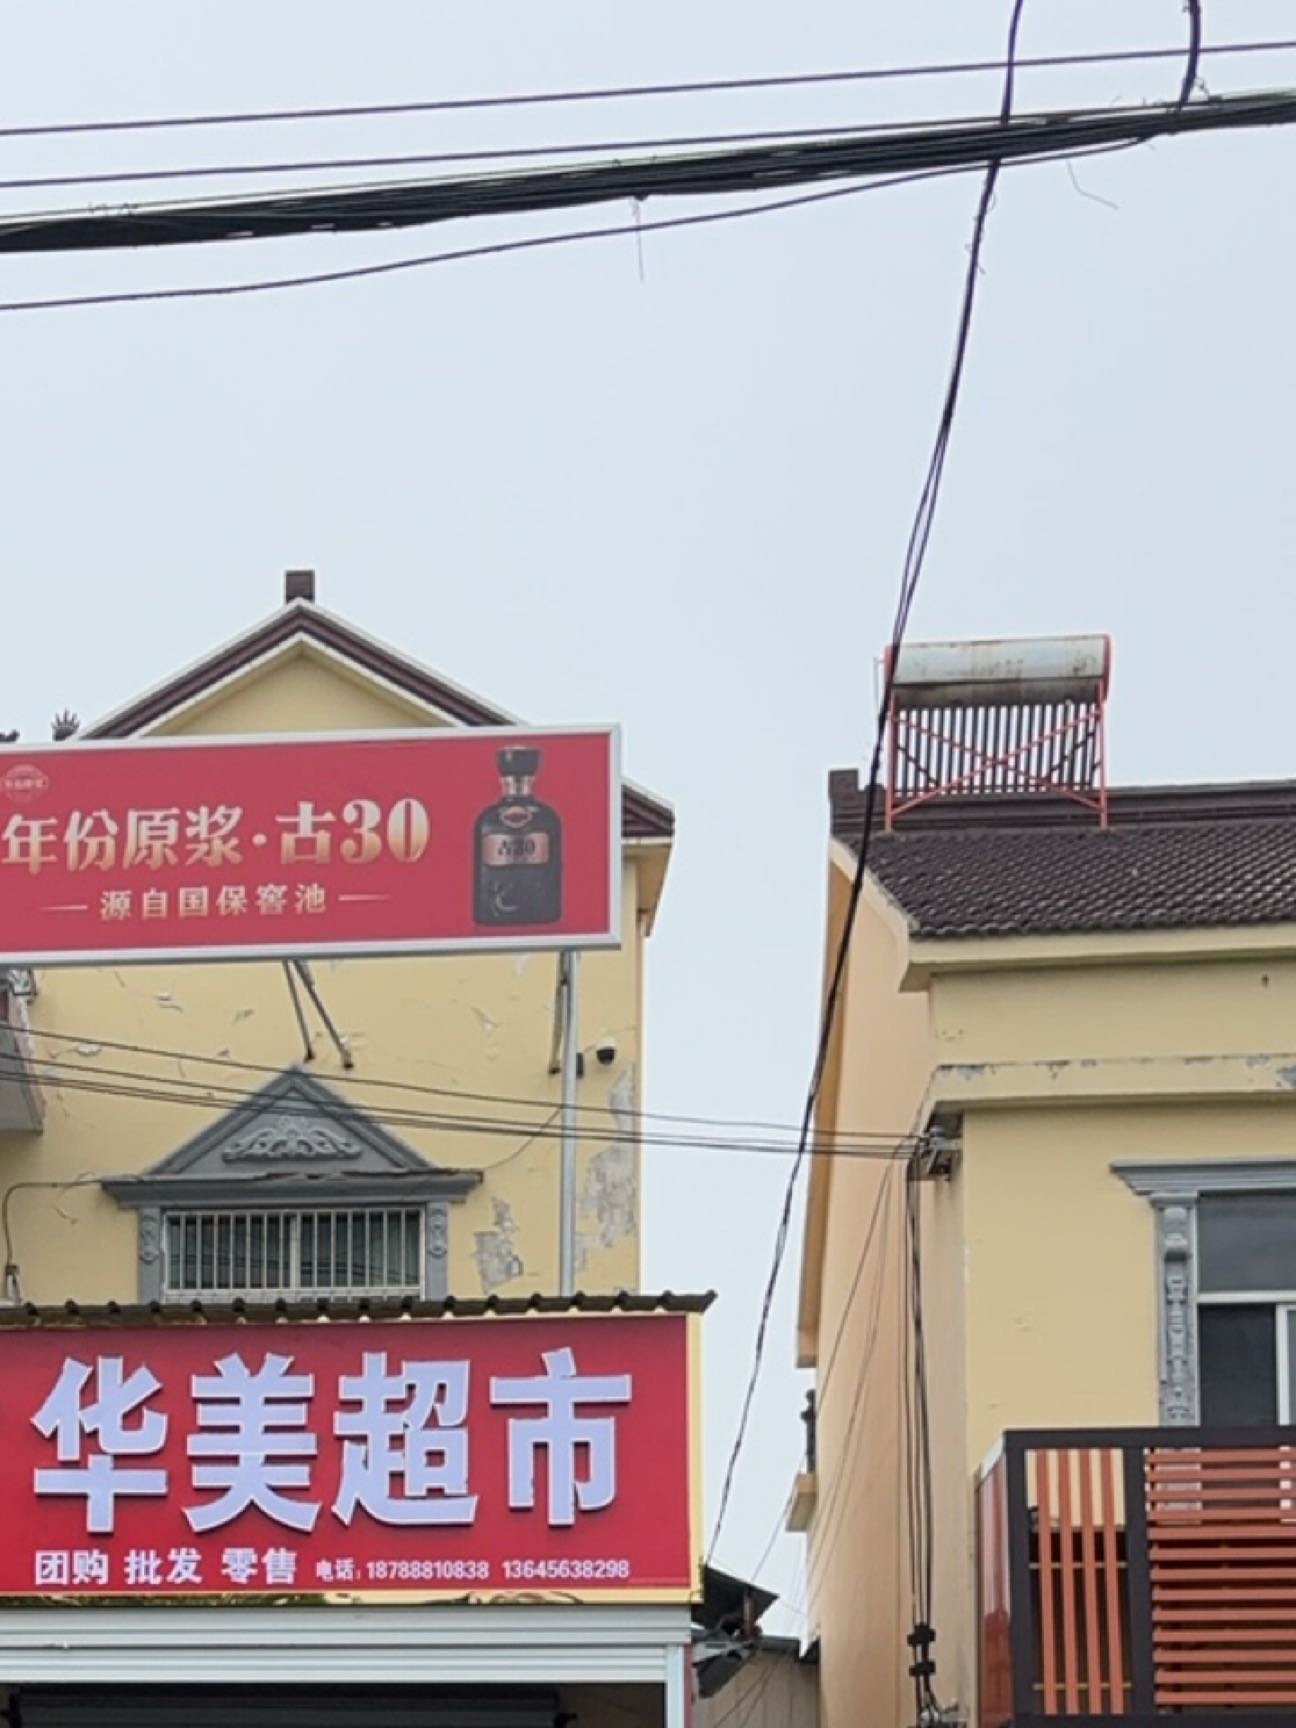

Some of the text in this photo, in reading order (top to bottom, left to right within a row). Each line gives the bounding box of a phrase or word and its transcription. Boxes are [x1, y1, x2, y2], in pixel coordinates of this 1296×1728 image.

[0, 798, 431, 875] 年份原浆·古30
[99, 883, 326, 921] 源自国保窖池
[28, 1345, 633, 1534] 华美超市
[34, 1552, 109, 1585] 团购
[124, 1550, 203, 1585] 批发
[221, 1548, 298, 1585] 零售
[366, 1560, 489, 1580] 18788810838
[502, 1559, 629, 1580] 13645638298
